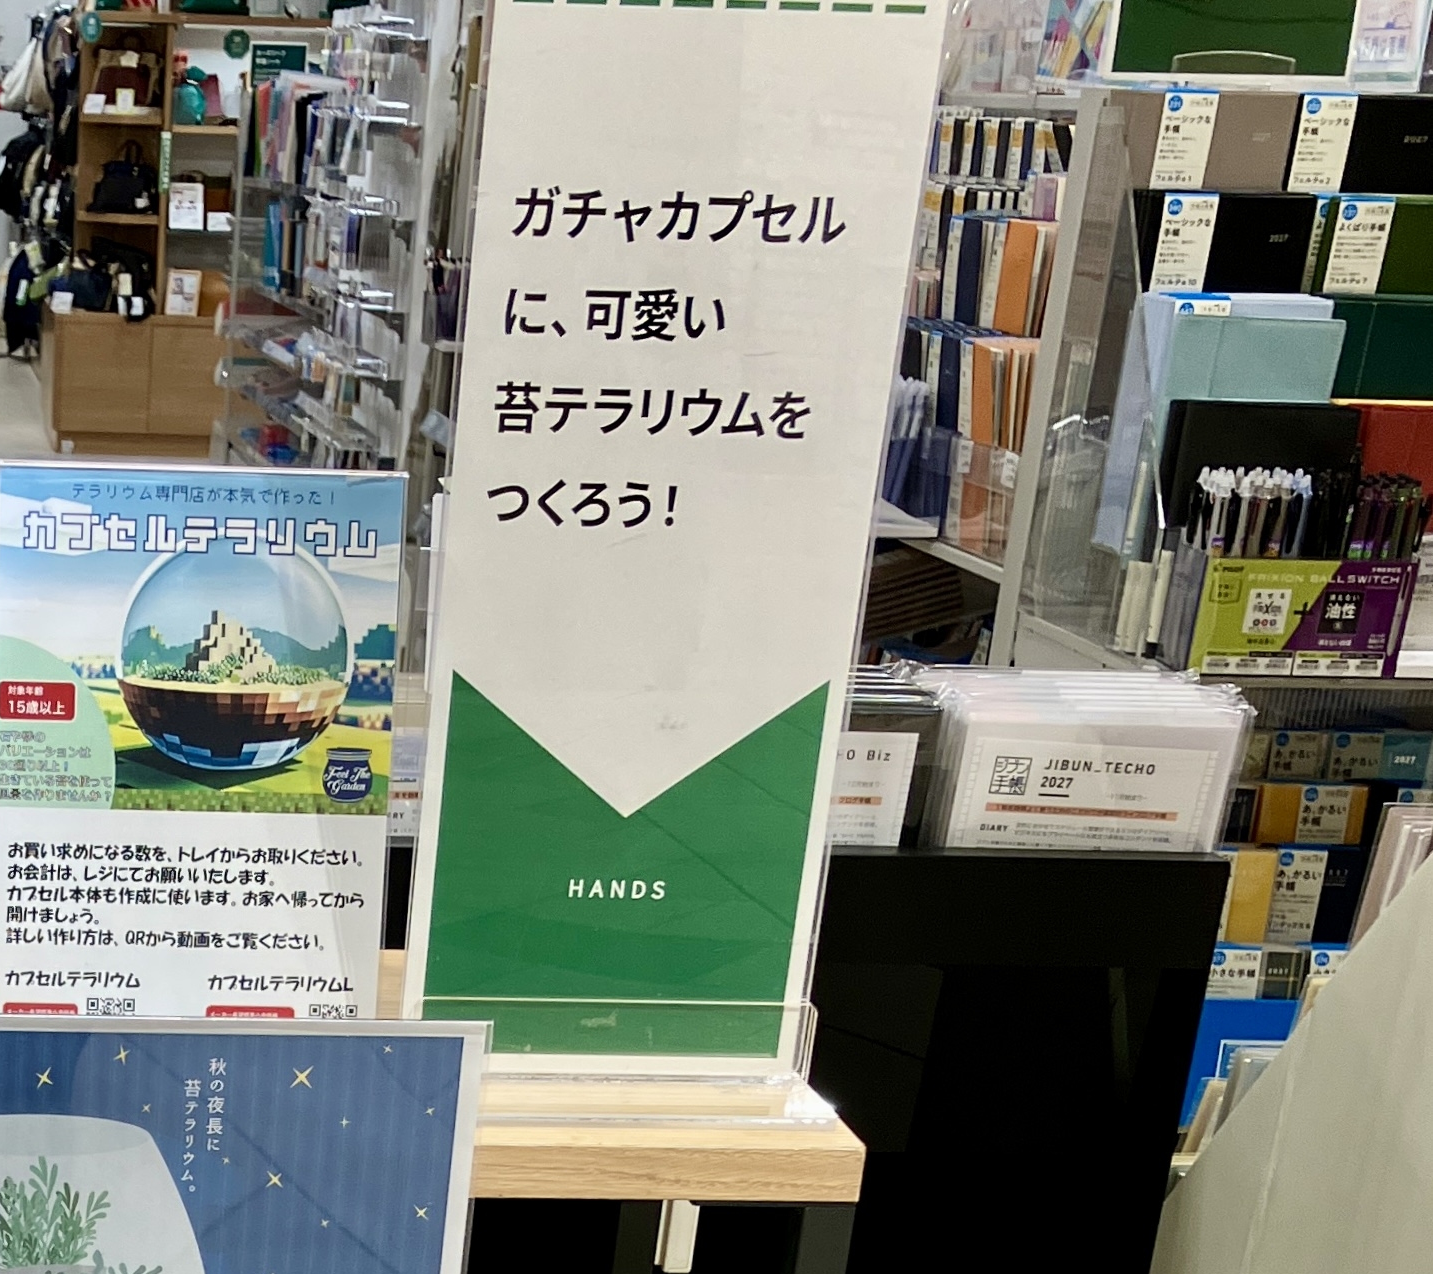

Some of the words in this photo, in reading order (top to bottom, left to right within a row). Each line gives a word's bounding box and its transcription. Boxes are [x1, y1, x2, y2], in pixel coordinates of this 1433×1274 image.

[511, 187, 847, 245] ガチャカプセル
[504, 287, 727, 341] に、可愛い
[495, 381, 809, 439] 苔テラリウムを
[71, 482, 336, 506] テラリウム専門店が本気で作った！
[486, 479, 677, 528] つくろう！
[22, 510, 378, 559] カプセルテラリウム
[8, 686, 44, 697] 対象年齢
[7, 700, 66, 716] 15歳以上
[867, 750, 891, 762] Biz
[1044, 758, 1156, 776] JIBUN_TECHO
[327, 780, 366, 793] Garden
[1040, 776, 1074, 790] 2027
[979, 823, 1009, 834] DIARY
[7, 842, 363, 866] お買い求めになる数を、トレイからお取りください。
[7, 863, 275, 886] お会計は、レジにてお願いいたします。
[7, 886, 365, 909] カプセル本体も作成に使います。お家へ帰ってから
[567, 878, 666, 901] HANDS
[6, 908, 100, 925] 開けましょう。
[5, 928, 325, 951] 詳しい作り方は、QRから動画をご覧ください。
[4, 970, 141, 989] カプセルテラリウム
[208, 974, 353, 993] カプセルテラリウムL
[208, 1057, 227, 1153] 秋の夜長に
[182, 1079, 201, 1193] 苔テラリウム。
